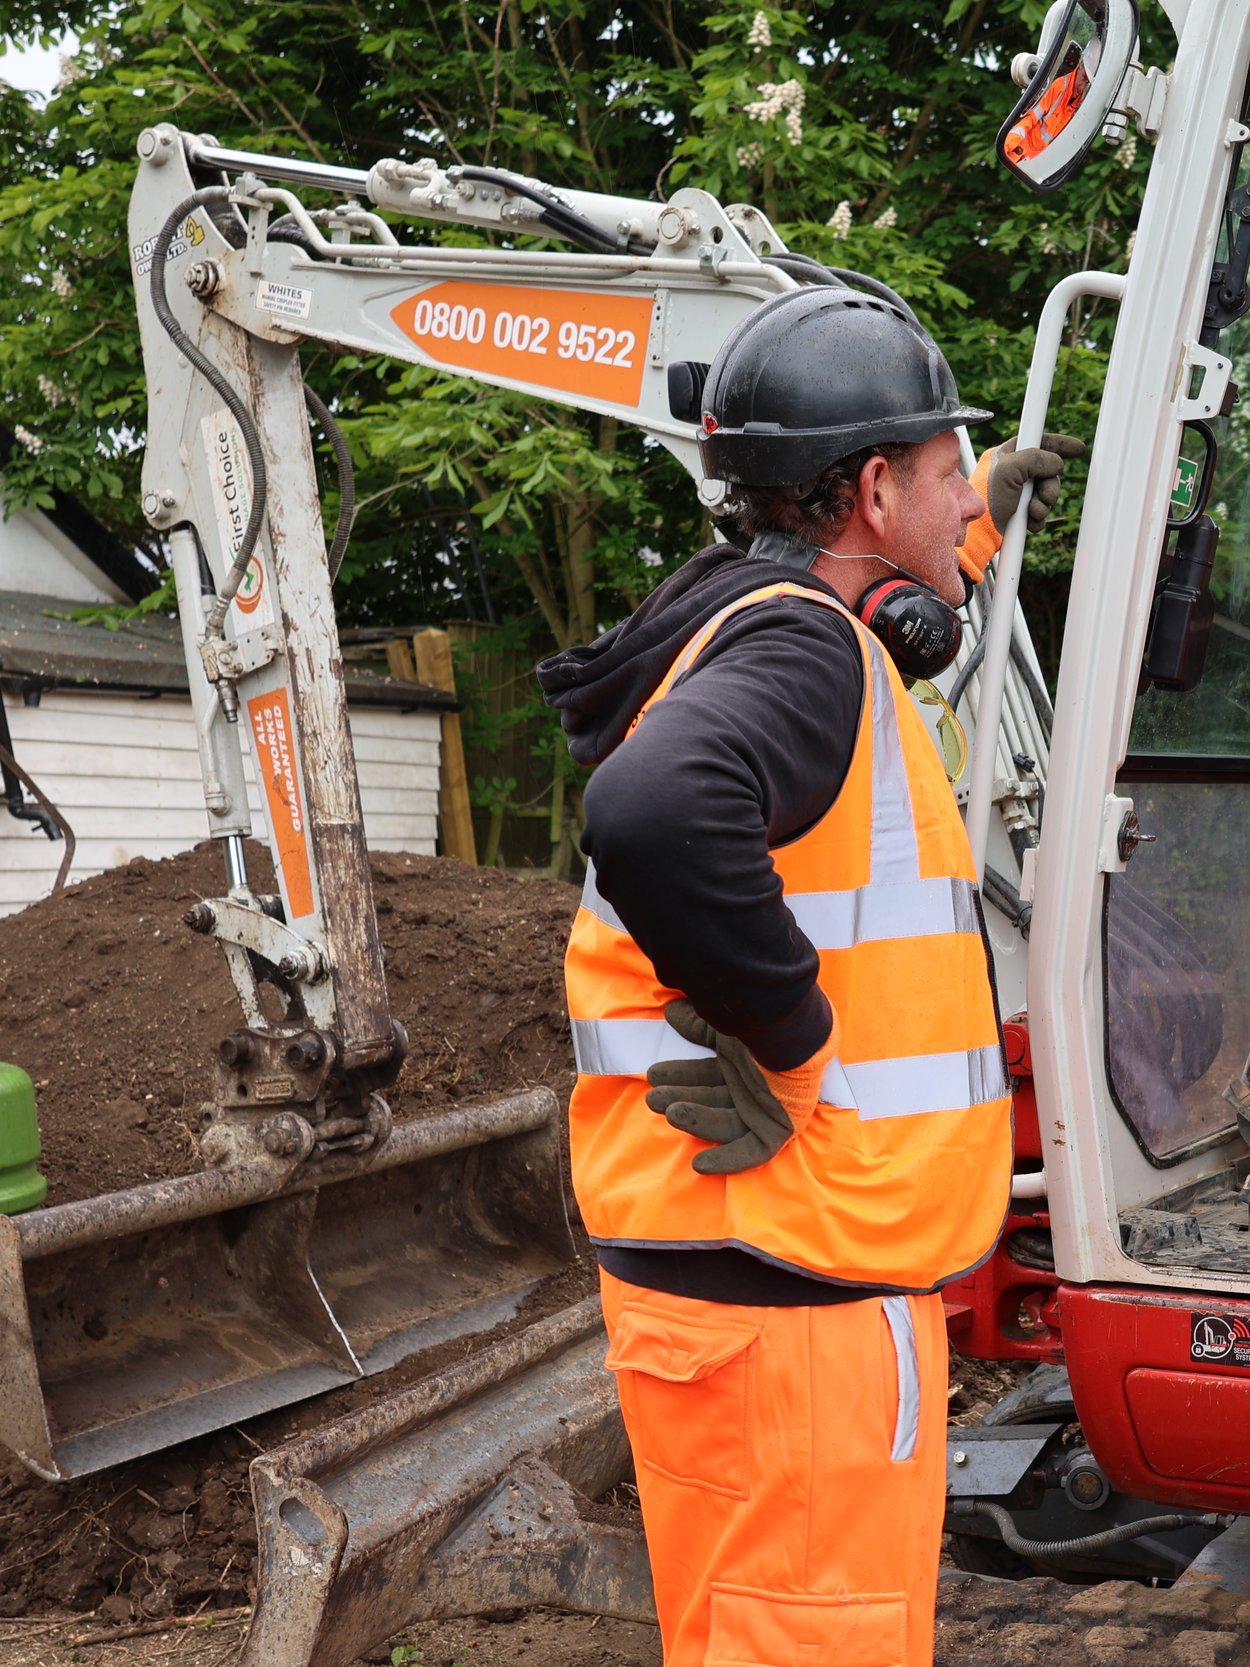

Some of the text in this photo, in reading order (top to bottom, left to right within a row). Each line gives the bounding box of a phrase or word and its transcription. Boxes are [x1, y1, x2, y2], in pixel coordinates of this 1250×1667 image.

[166, 242, 187, 262] LTD.
[268, 283, 303, 300] WHITES
[413, 299, 637, 369] 0800 002 9522
[218, 431, 246, 553] First Choice
[901, 620, 914, 635] 3M
[254, 710, 267, 745] ALL
[264, 707, 282, 776] WORKS
[273, 704, 302, 832] GUARANTEED
